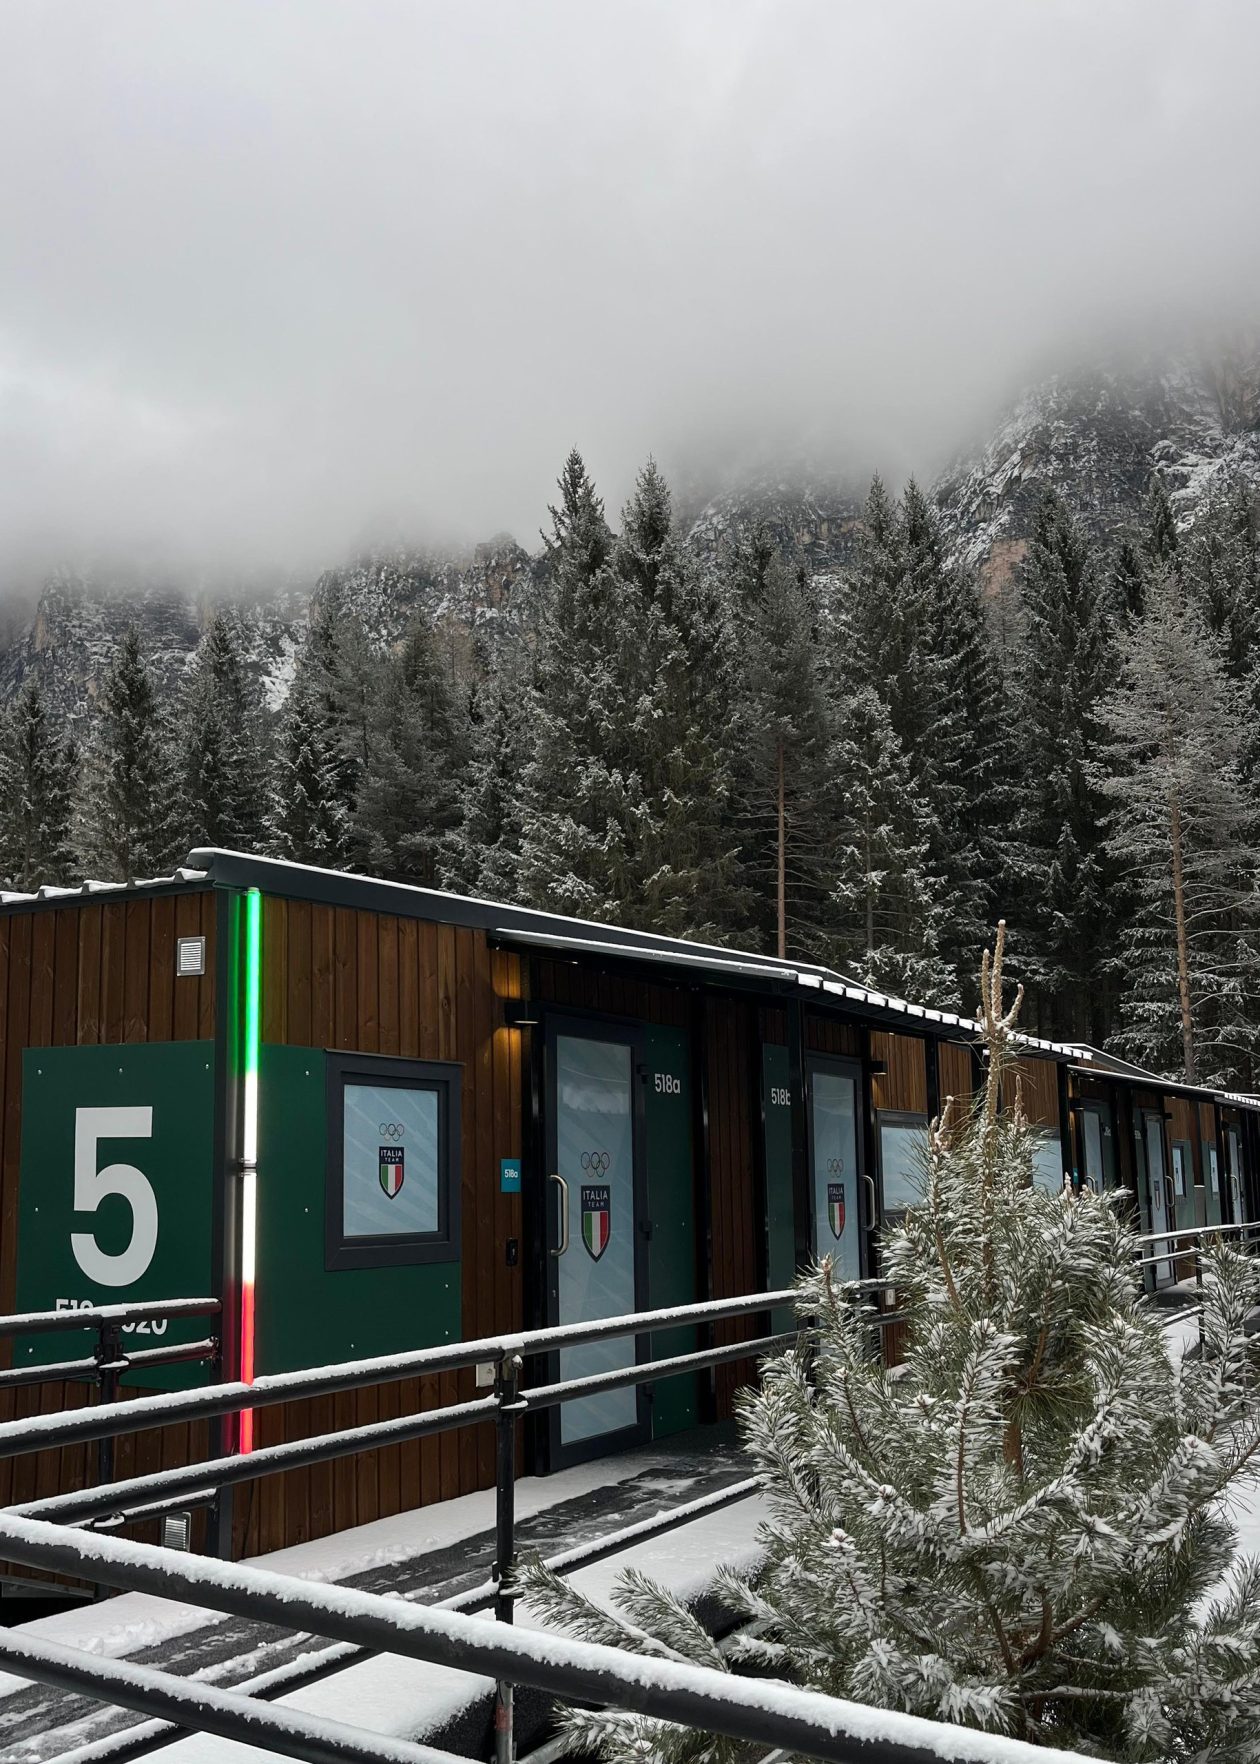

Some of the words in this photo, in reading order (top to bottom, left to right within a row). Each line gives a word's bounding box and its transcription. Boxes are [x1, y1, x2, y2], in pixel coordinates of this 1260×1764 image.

[654, 1073, 681, 1094] 518a
[771, 1087, 791, 1106] 518b
[380, 1149, 403, 1158] ITALIA
[504, 1168, 519, 1178] 518a
[582, 1190, 609, 1201] ITALIA
[828, 1186, 844, 1195] ITALIA
[70, 1106, 159, 1287] 5
